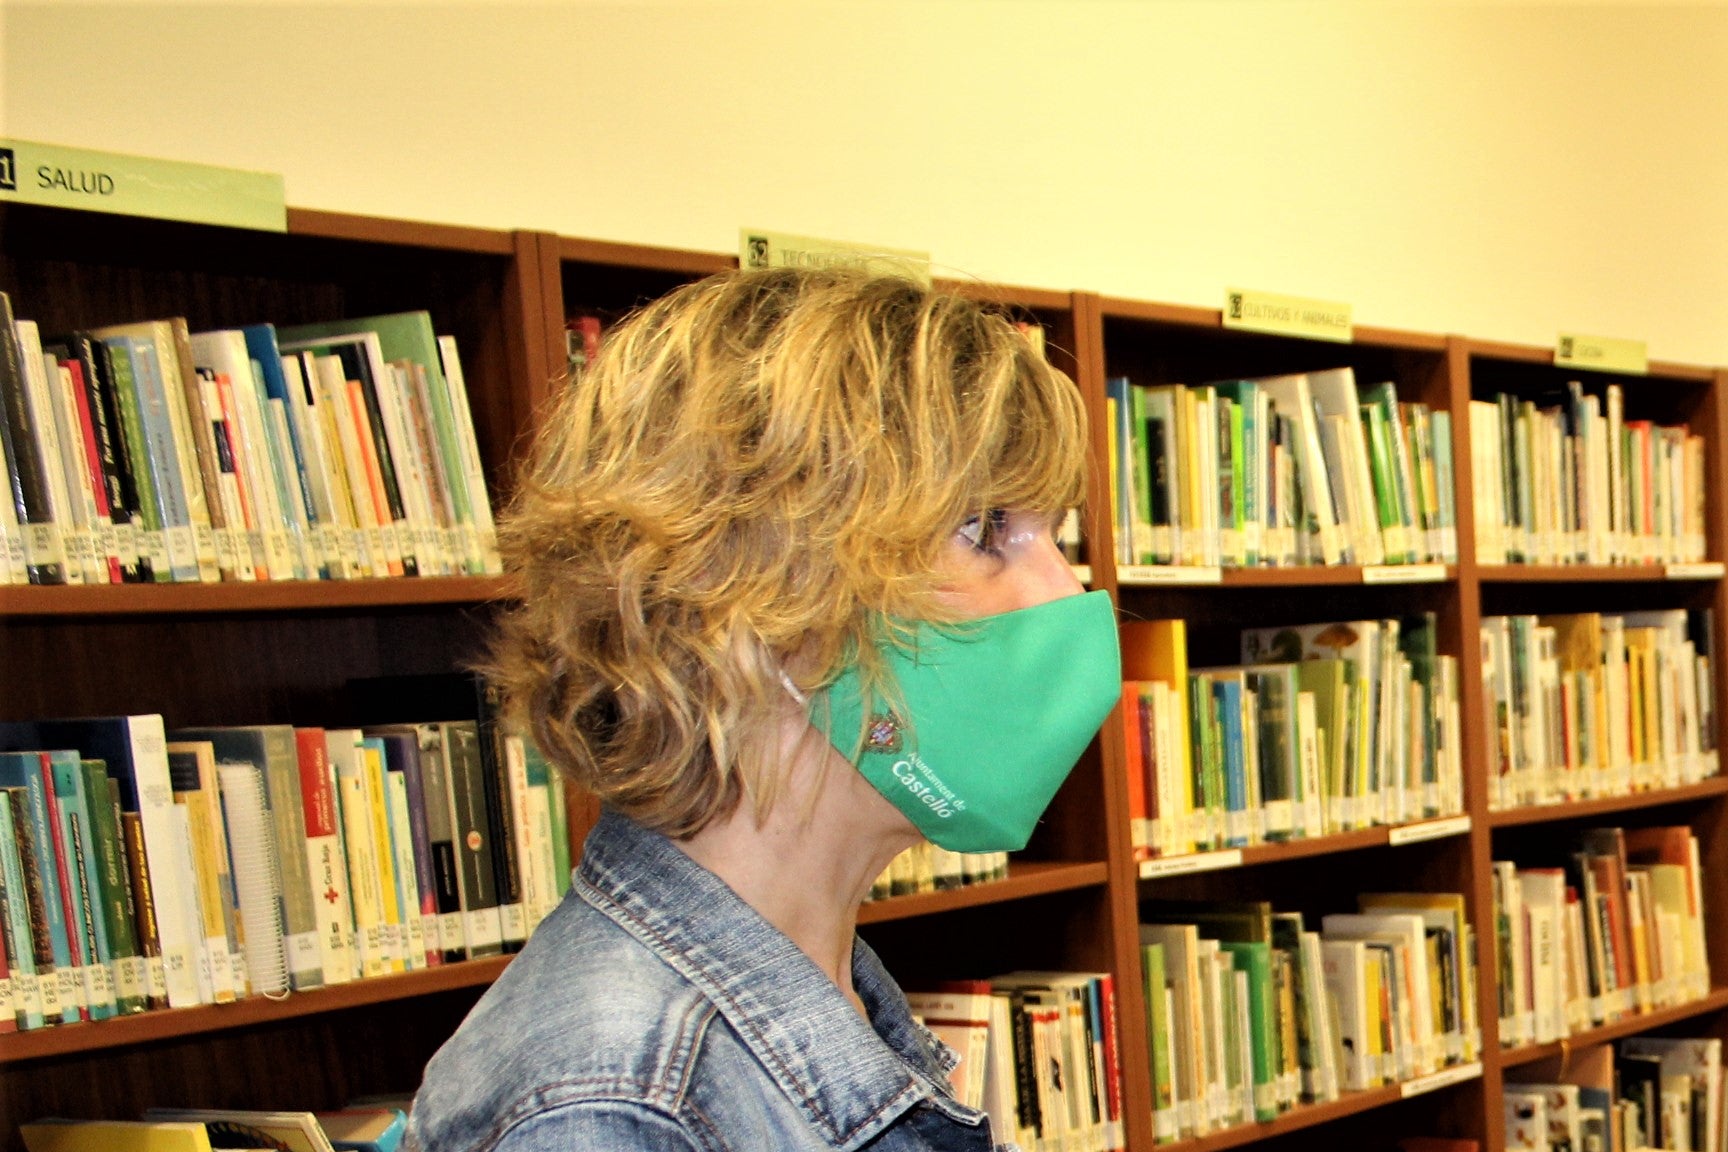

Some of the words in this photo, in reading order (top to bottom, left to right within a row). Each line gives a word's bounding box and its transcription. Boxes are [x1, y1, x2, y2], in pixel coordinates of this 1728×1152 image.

[37, 166, 115, 195] SALUD
[891, 760, 957, 819] Castelló
[953, 794, 966, 811] de
